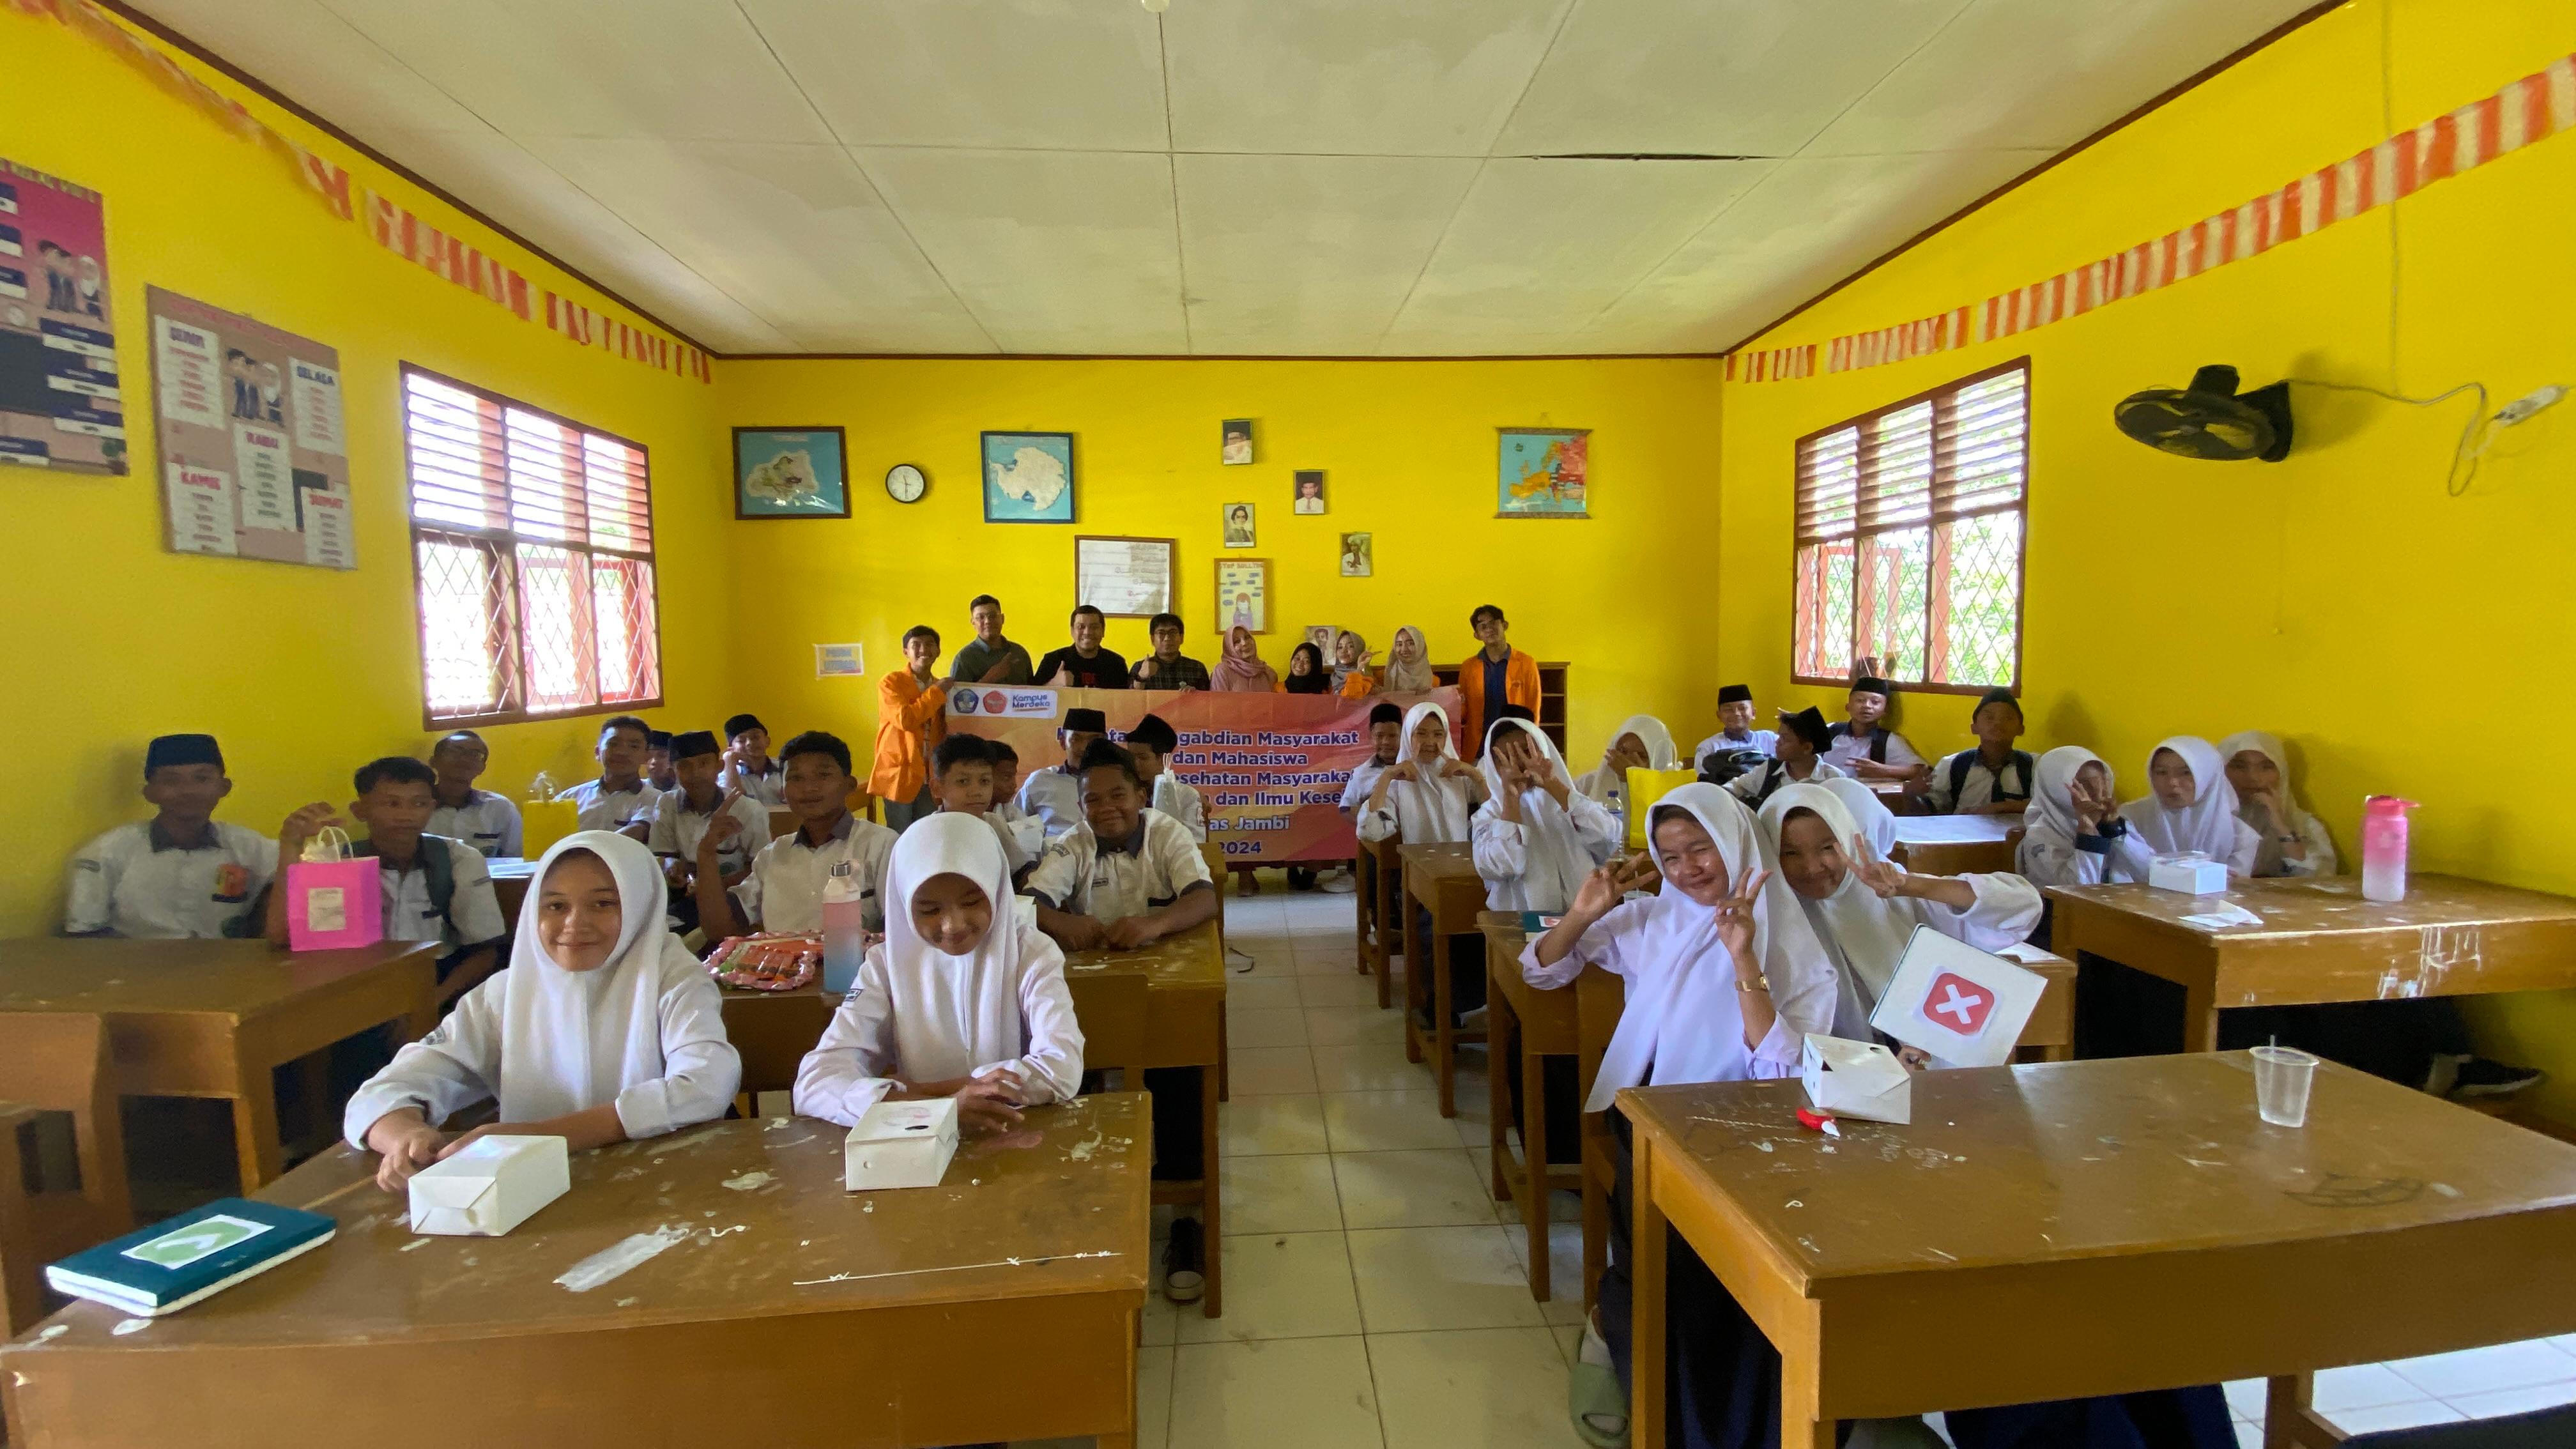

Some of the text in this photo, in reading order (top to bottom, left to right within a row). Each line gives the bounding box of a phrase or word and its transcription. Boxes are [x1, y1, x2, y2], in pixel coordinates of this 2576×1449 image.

[1013, 694, 1047, 703] Kampus
[1178, 730, 1359, 748] gabdian Masyarakat
[1172, 751, 1308, 765] dan Mahasiswa
[1176, 771, 1252, 786] sehatan
[1215, 790, 1249, 806] dan
[1255, 792, 1294, 805] Ilmu
[1300, 790, 1346, 804] Kese
[1234, 815, 1290, 831] Jambi
